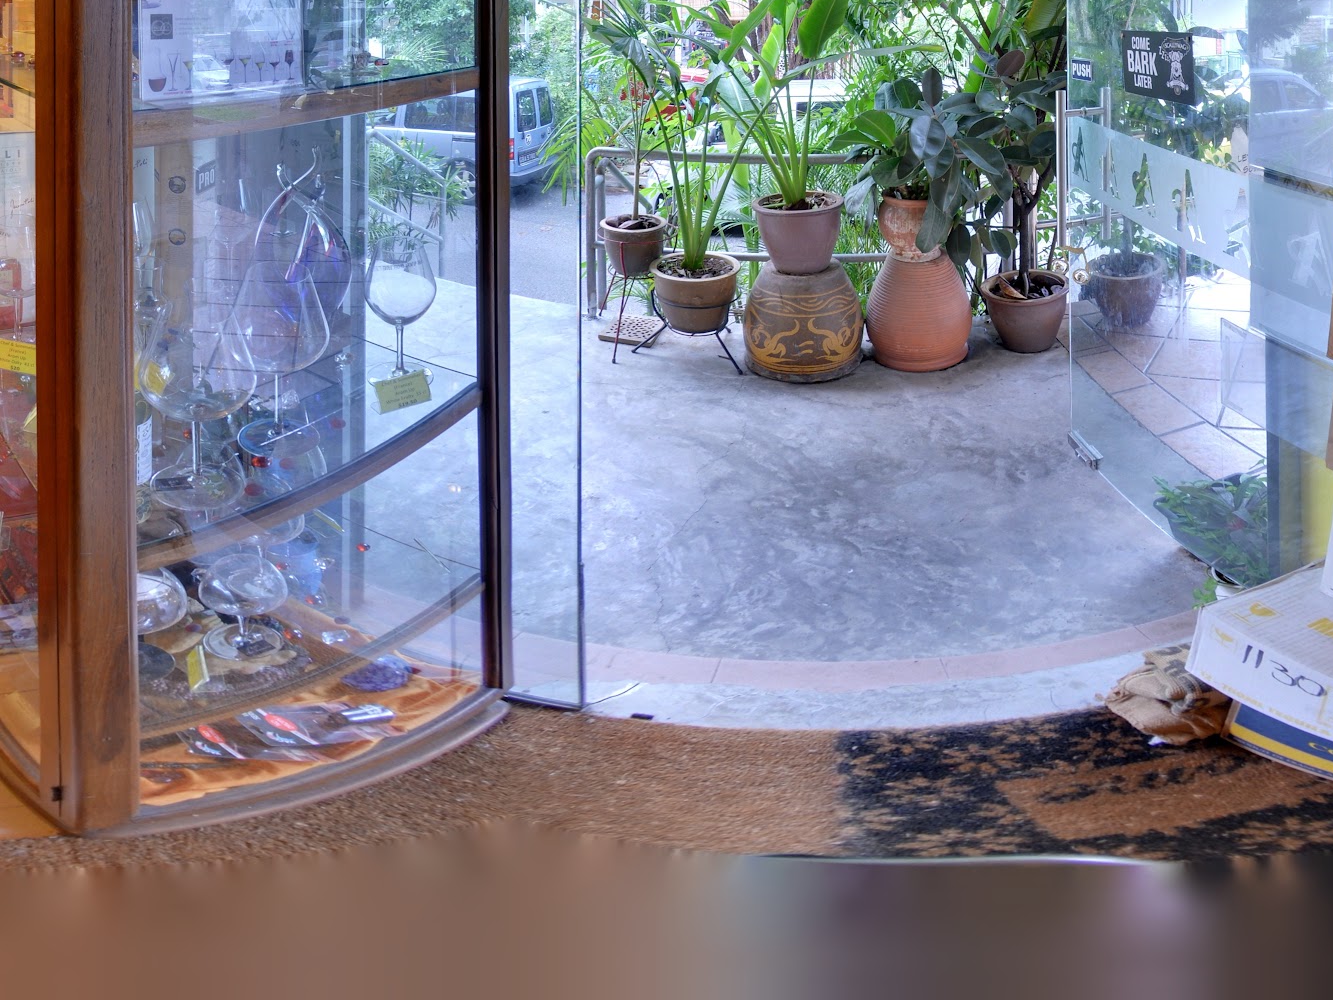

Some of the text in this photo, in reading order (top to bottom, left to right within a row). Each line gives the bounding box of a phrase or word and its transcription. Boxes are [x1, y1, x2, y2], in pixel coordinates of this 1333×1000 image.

[1131, 36, 1151, 51] COME
[1072, 62, 1092, 78] PUSH
[1127, 50, 1158, 76] BARK
[1134, 74, 1153, 90] LATER
[198, 168, 215, 188] PRO
